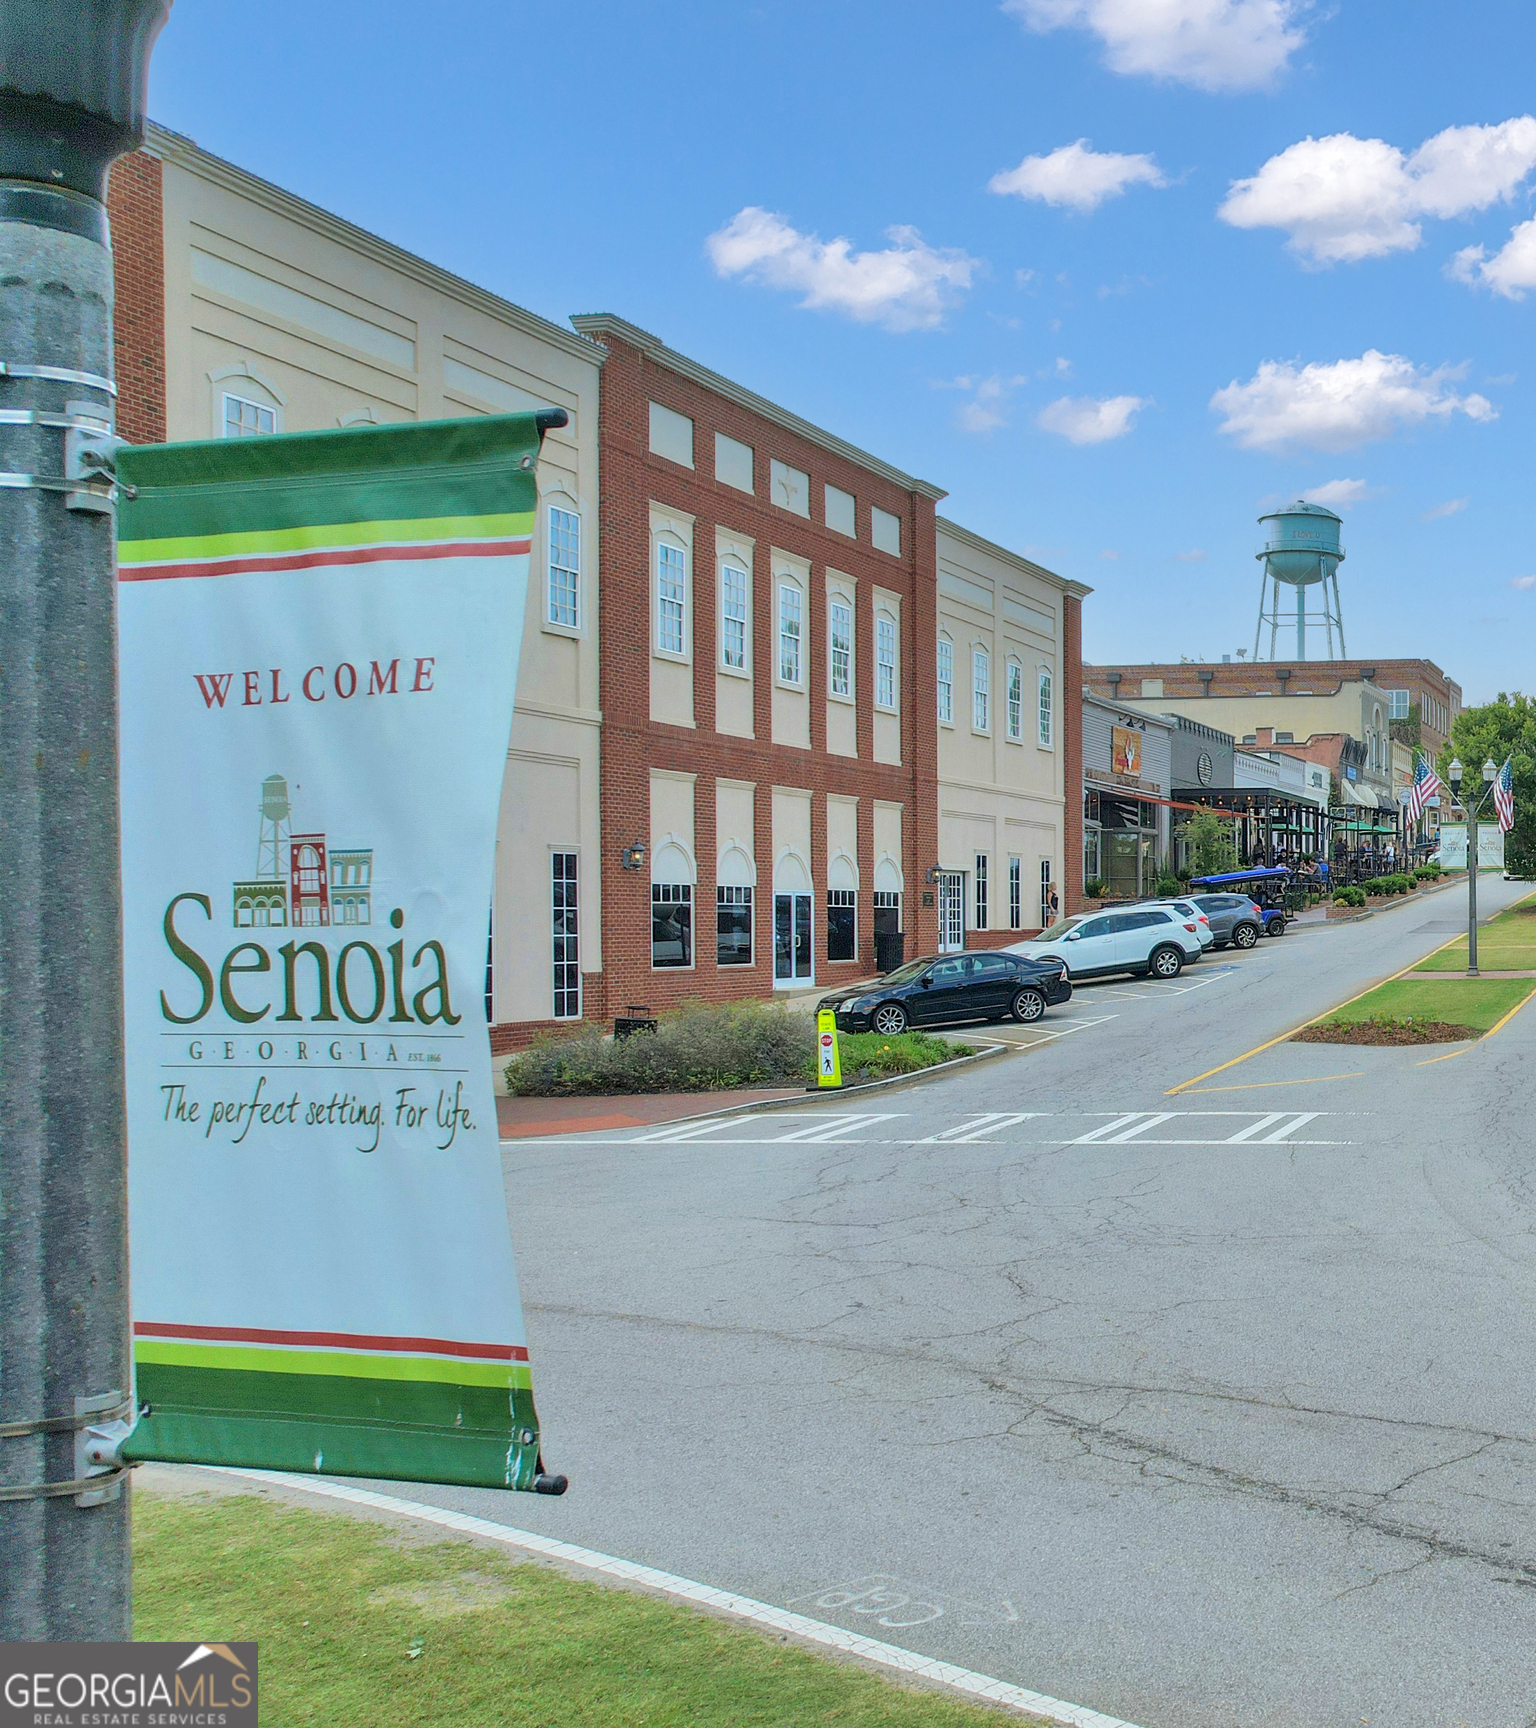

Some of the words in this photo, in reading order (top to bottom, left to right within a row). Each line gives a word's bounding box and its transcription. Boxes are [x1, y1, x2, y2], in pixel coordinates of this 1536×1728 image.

[193, 656, 437, 710] WELCOME
[159, 892, 463, 1027] Senoia
[160, 1084, 201, 1122] The
[205, 1076, 300, 1143] perfect
[305, 1092, 385, 1153] setting.
[396, 1087, 428, 1128] For
[437, 1080, 477, 1150] life.
